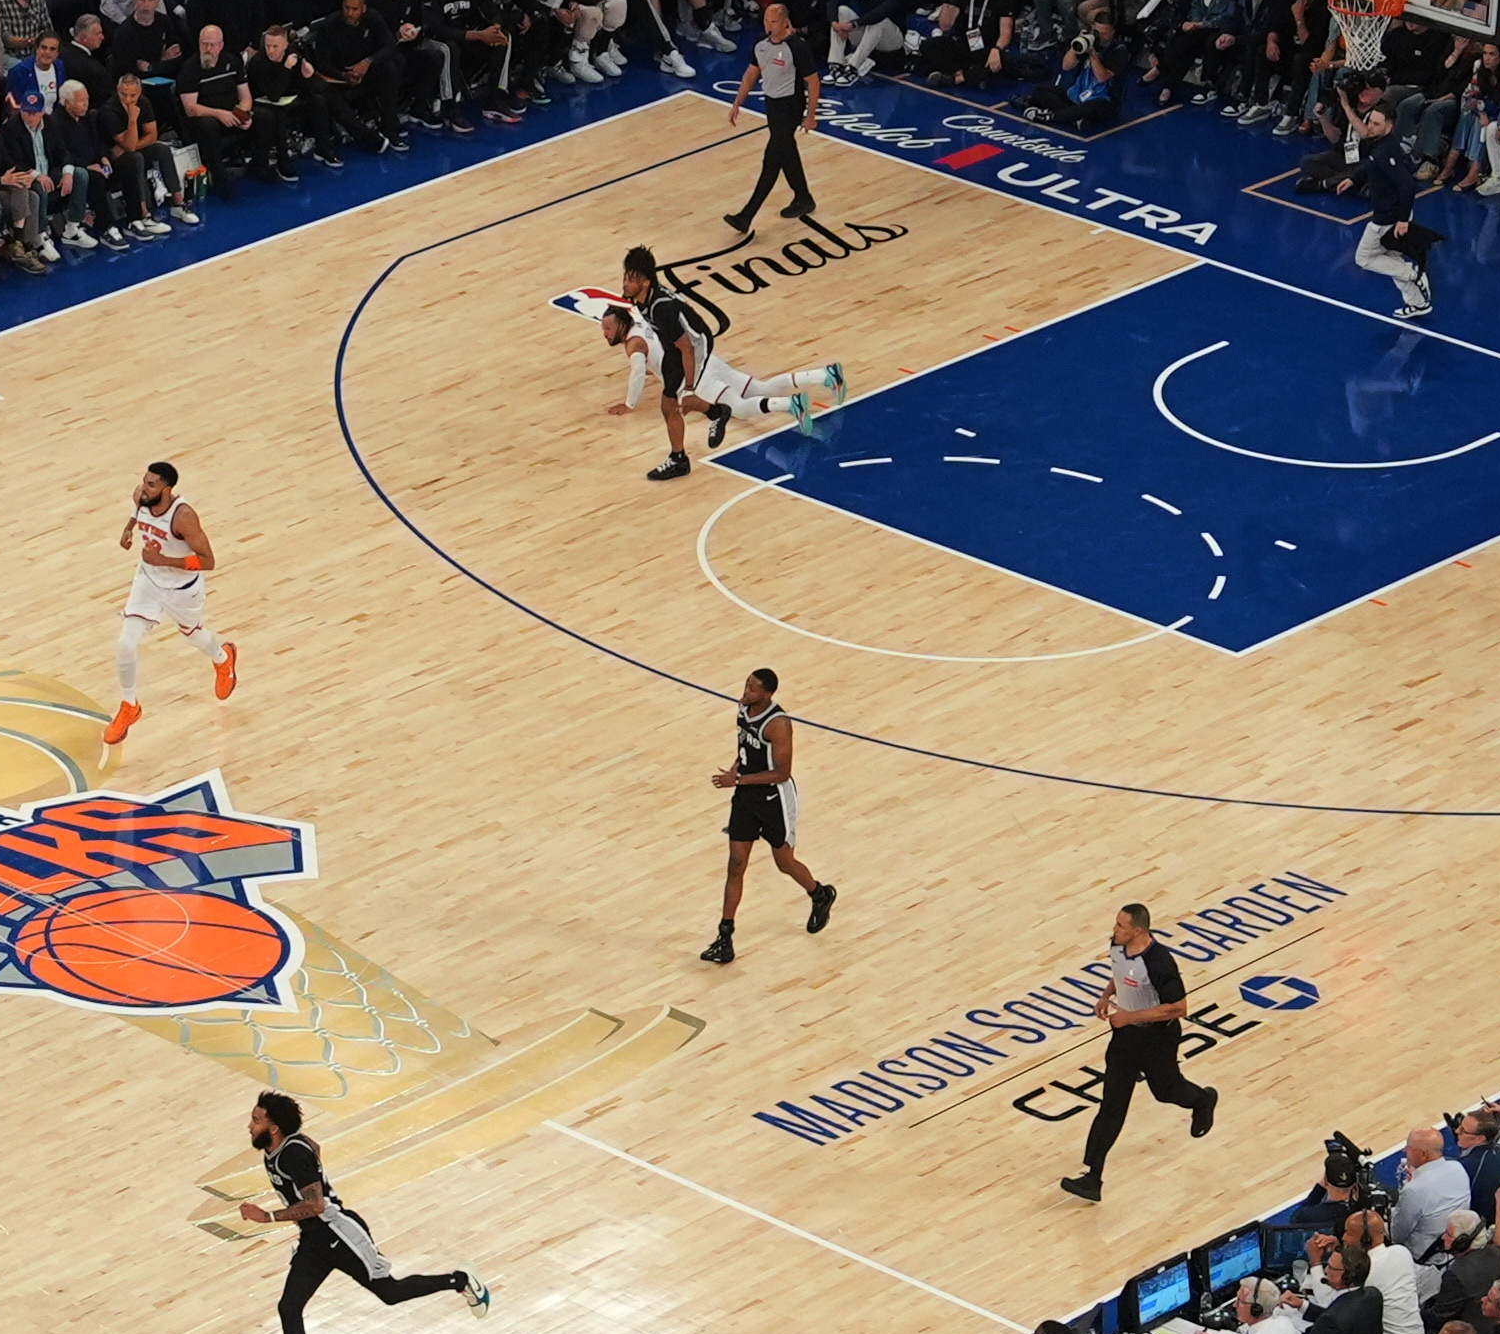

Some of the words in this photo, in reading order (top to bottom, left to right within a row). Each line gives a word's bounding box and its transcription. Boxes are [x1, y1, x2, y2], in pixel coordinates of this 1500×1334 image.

[943, 115, 1087, 164] Courtside
[997, 161, 1218, 246] ULTRA
[650, 224, 909, 337] Finals
[753, 1031, 1001, 1147] MADISON
[1152, 872, 1347, 963] GARDEN
[1013, 1002, 1261, 1122] CHSE
